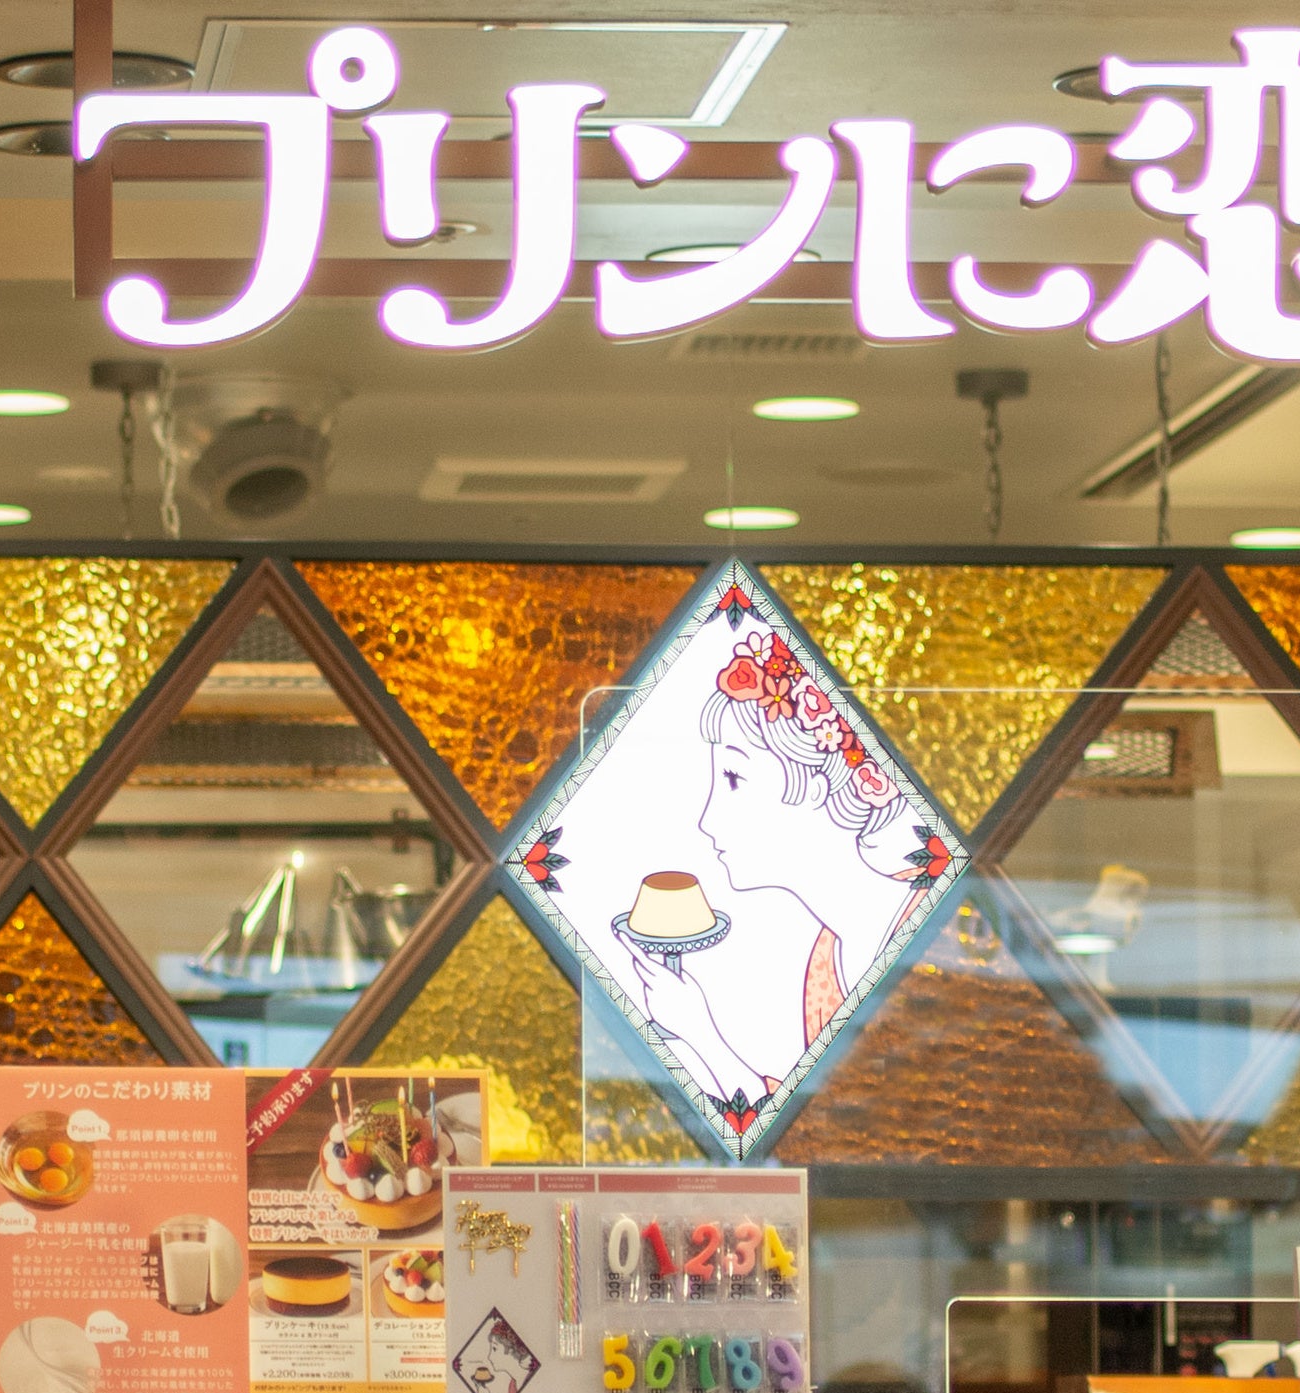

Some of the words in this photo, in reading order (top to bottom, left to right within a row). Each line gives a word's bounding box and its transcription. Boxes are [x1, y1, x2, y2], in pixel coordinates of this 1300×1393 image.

[22, 1080, 213, 1102] プリンのこだわり素材
[250, 1191, 341, 1205] 特別な日にみんなで
[250, 1209, 356, 1223] アレンジしても楽しめる
[40, 1221, 131, 1235] 北海道美瑛産の
[25, 1236, 149, 1251] ジャージー牛乳を使用
[608, 1217, 641, 1276] 0
[642, 1221, 679, 1277] 1
[684, 1223, 722, 1281] 2
[724, 1222, 763, 1277] 3
[763, 1224, 798, 1279] 4
[141, 1330, 180, 1343] 北海道
[113, 1346, 209, 1359] 生クリームを使用
[603, 1333, 636, 1391] 5
[645, 1336, 682, 1389] 6
[685, 1334, 719, 1393] 7
[725, 1336, 762, 1391] 8
[767, 1337, 804, 1391] 9
